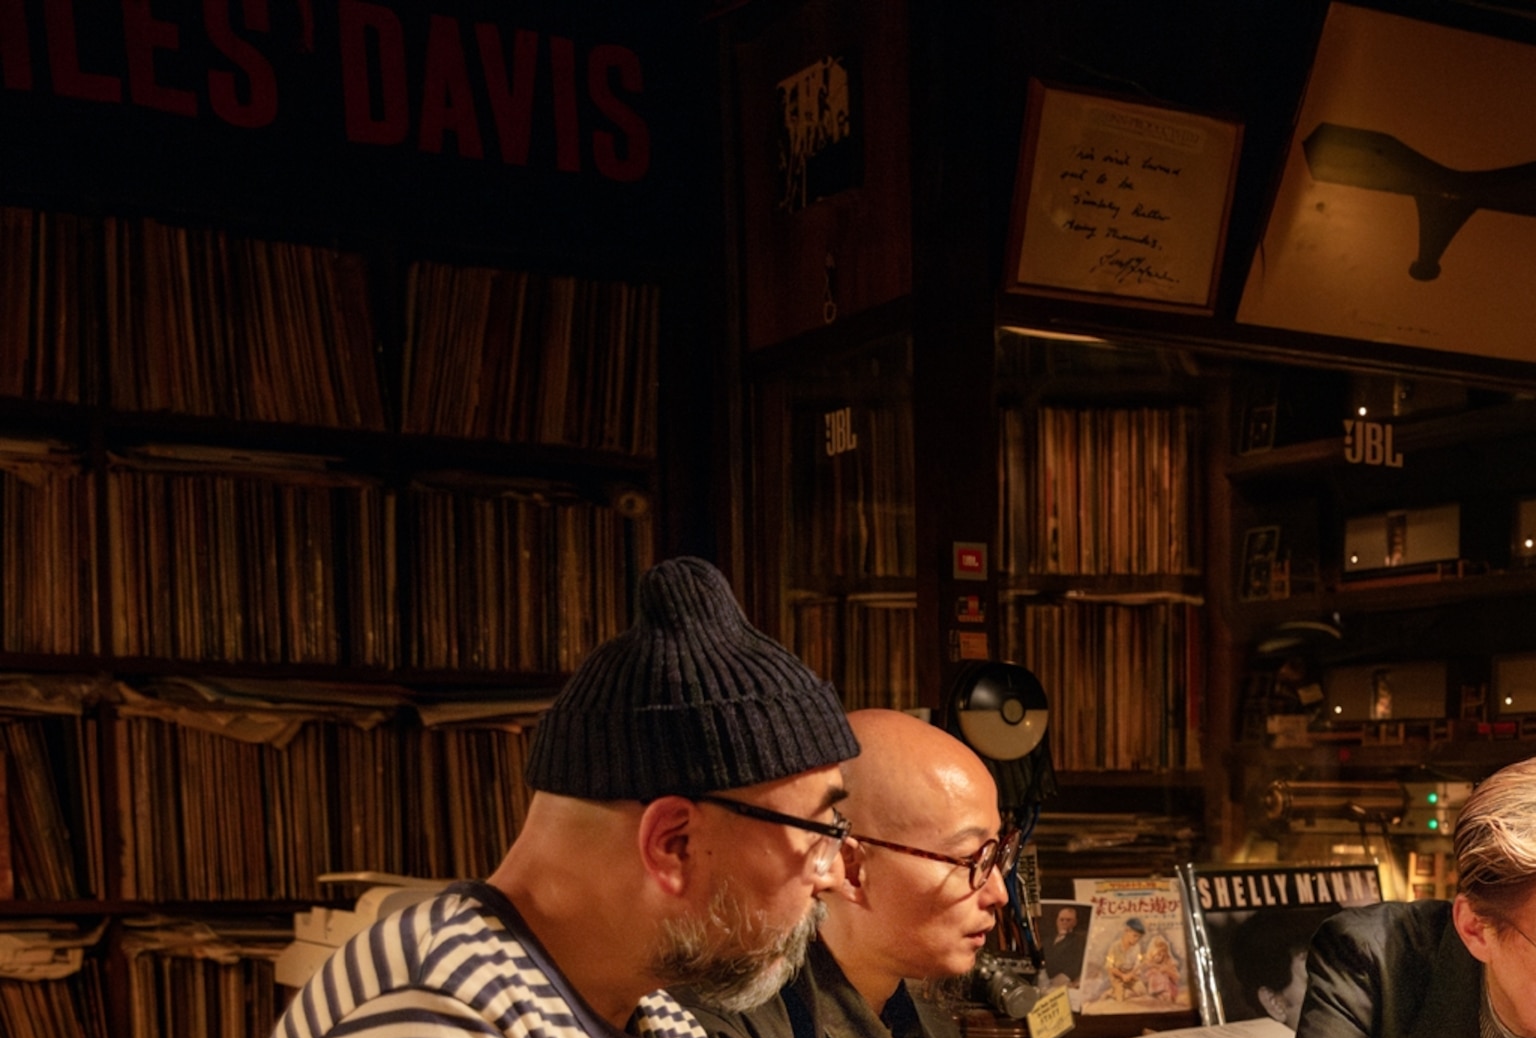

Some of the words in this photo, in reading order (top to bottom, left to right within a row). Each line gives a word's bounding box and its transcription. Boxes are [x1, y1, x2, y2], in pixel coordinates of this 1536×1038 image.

[337, 0, 652, 183] DAVIS
[824, 406, 858, 456] JBL
[1342, 418, 1404, 468] JBL
[1197, 873, 1289, 910] SHELLY
[1295, 869, 1381, 905] MANNE
